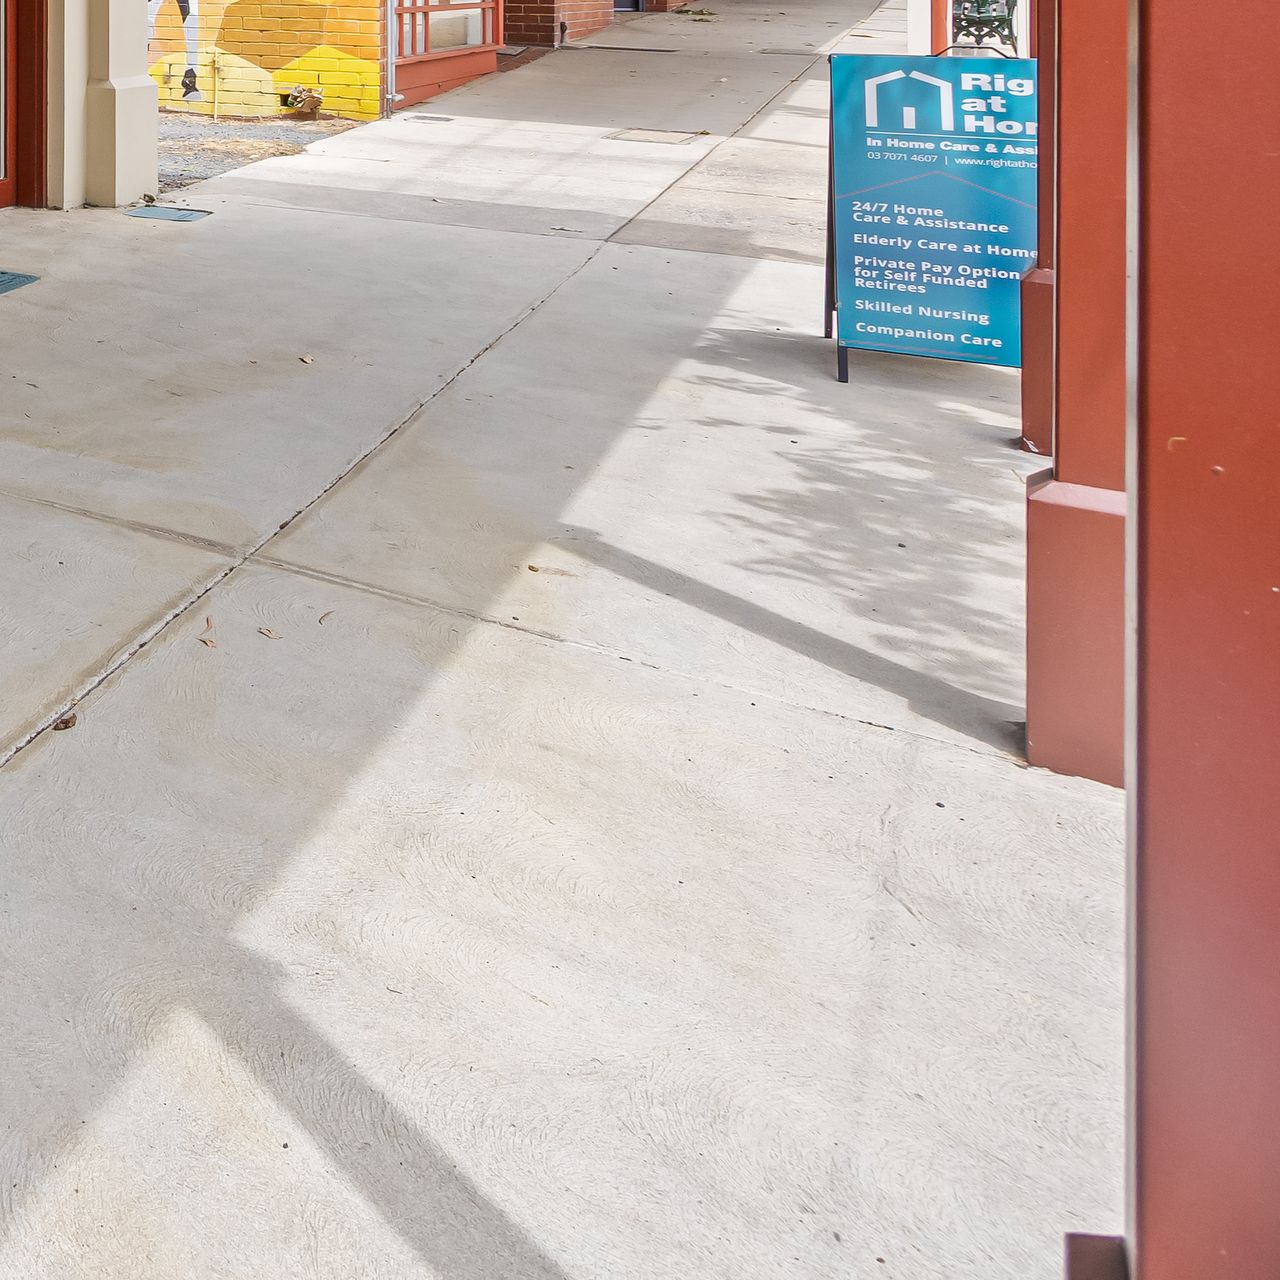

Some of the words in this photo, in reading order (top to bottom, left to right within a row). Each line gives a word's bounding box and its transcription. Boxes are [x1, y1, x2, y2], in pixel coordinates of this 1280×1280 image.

[961, 73, 1034, 96] Rig
[961, 96, 1007, 112] at
[964, 114, 1038, 135] Ho
[866, 137, 882, 147] In
[886, 138, 935, 149] Home
[940, 141, 980, 152] Care
[985, 143, 998, 153] &
[867, 152, 881, 160] 03
[883, 152, 907, 161] 7071
[910, 154, 938, 163] 4607
[954, 158, 1038, 169] www.rightatho
[852, 201, 889, 213] 24/7
[893, 204, 944, 217] Home
[852, 212, 891, 224] Care
[896, 215, 909, 225] &
[914, 217, 1009, 233] Assistance
[853, 234, 912, 250] Elderly
[917, 239, 957, 252] Care
[963, 243, 982, 254] at
[988, 245, 1038, 259] Home
[853, 267, 878, 278] for
[884, 269, 917, 282] Self
[922, 273, 988, 289] Funded
[854, 255, 916, 270] Private
[921, 261, 952, 275] Pay
[957, 265, 1020, 280] Option
[855, 277, 926, 294] Retirees
[855, 299, 913, 316] Skilled
[918, 306, 989, 325] Nursing
[856, 321, 955, 343] Companion
[959, 333, 1002, 348] Care
